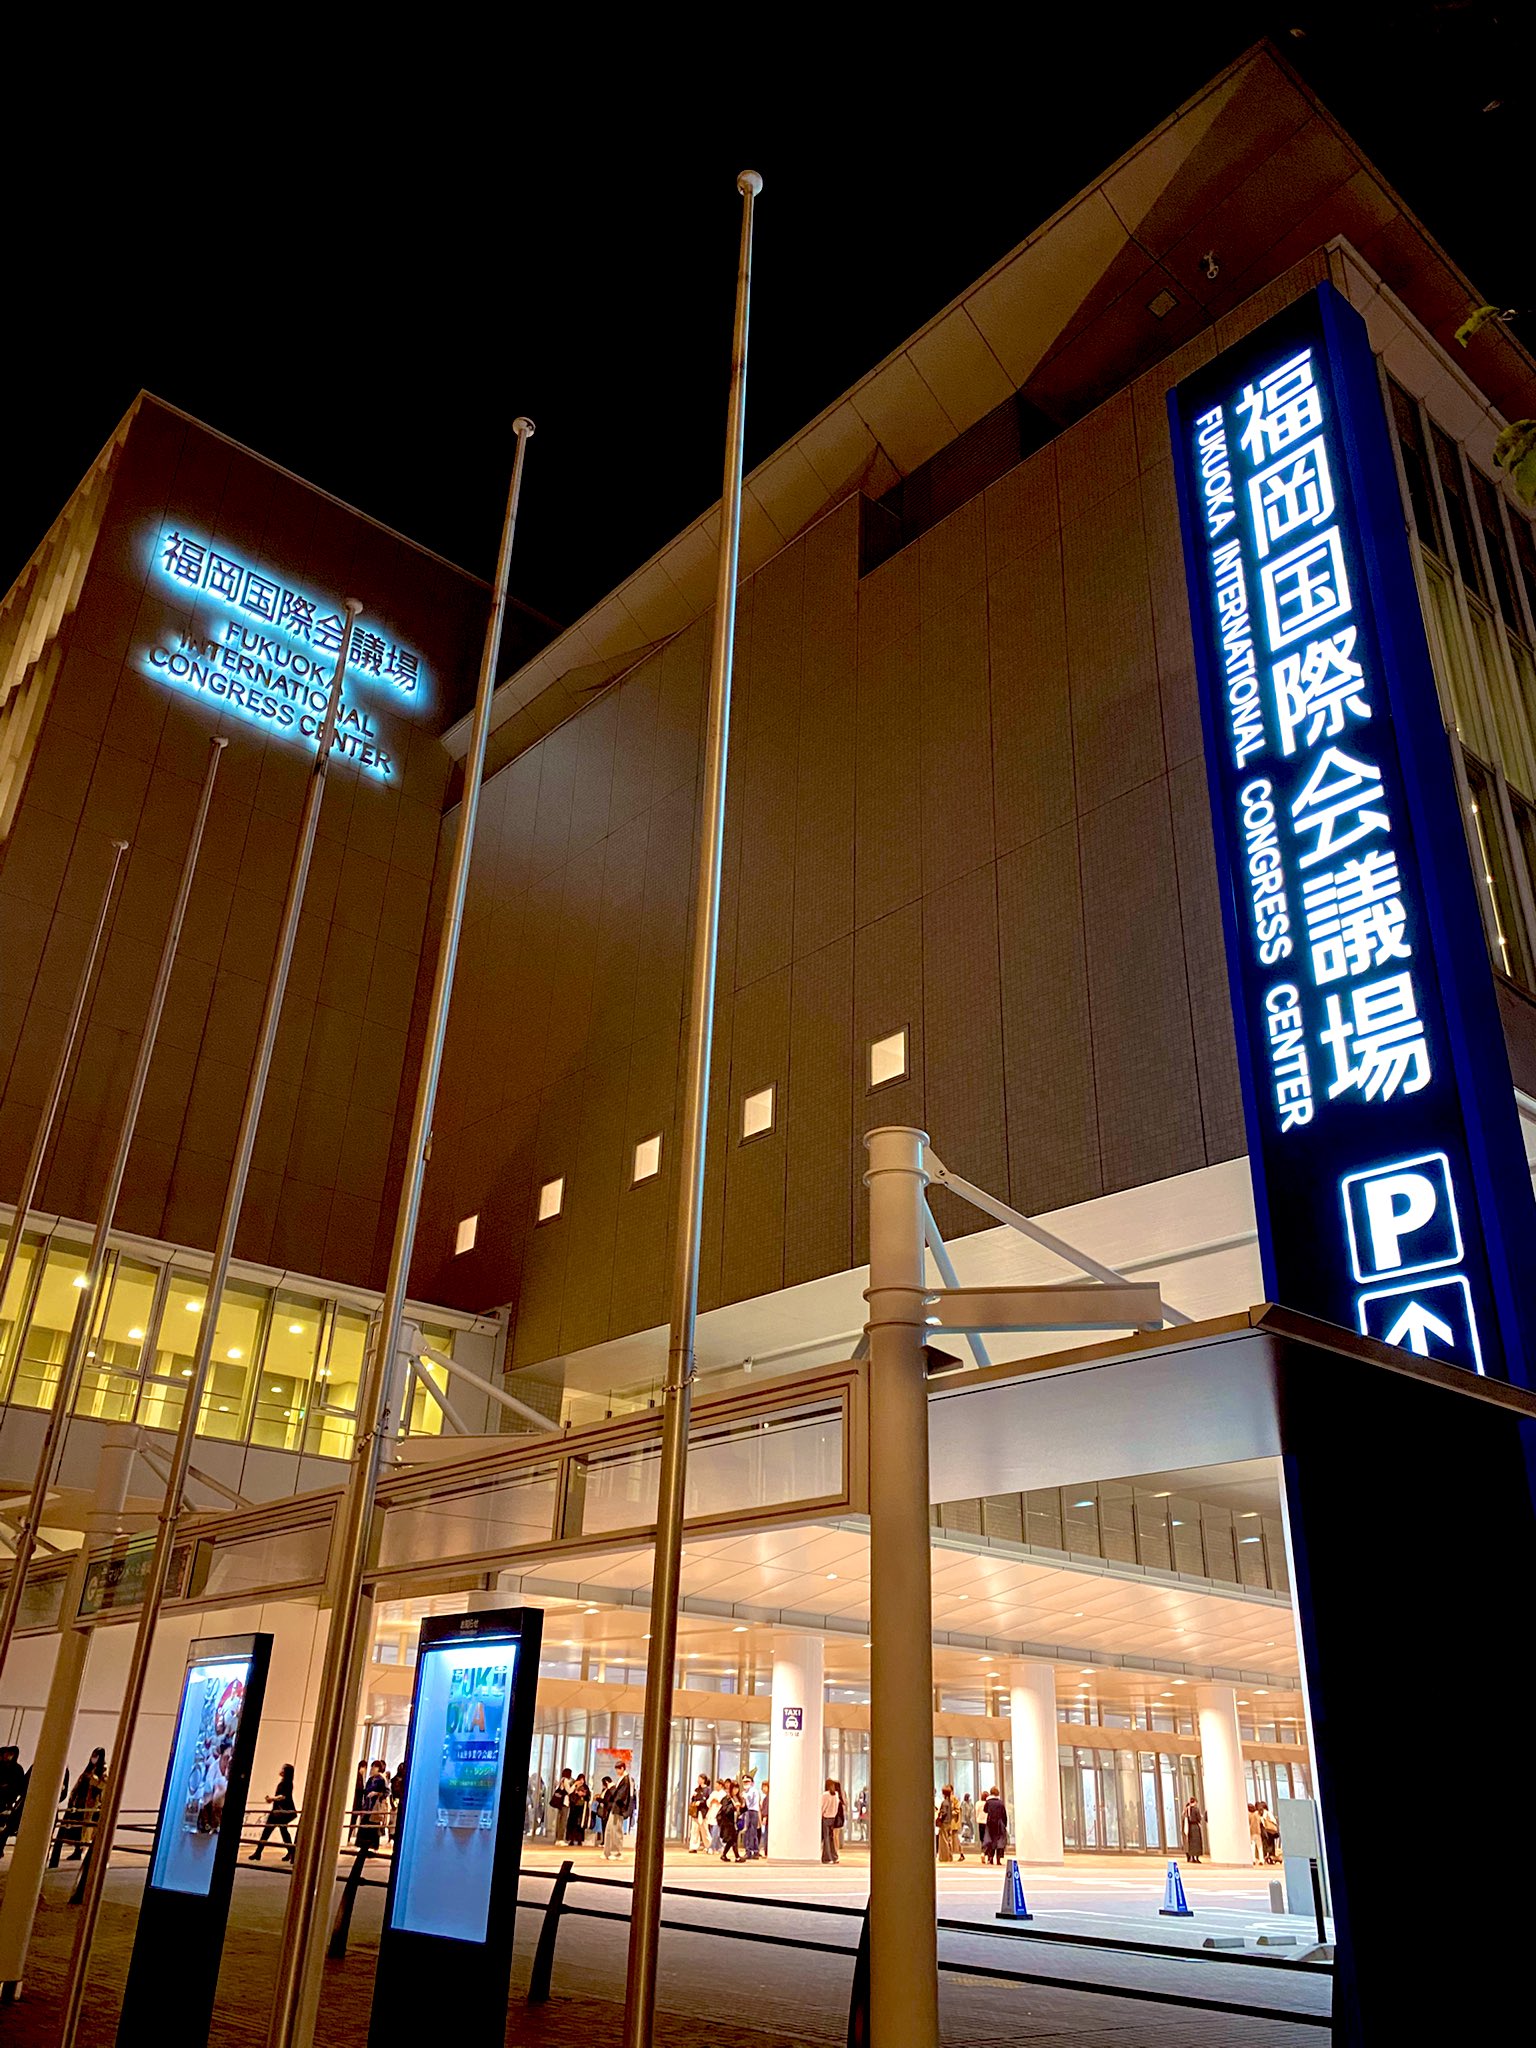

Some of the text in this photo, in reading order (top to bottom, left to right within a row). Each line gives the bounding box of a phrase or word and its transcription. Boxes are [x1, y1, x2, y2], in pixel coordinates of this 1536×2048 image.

[149, 645, 296, 727] CONGRESS
[163, 531, 419, 692] 福岡国際会議場
[1196, 404, 1315, 1134] FUKUOKA INTERNATIONAL CONGRESS CENTER
[1235, 347, 1433, 1103] 福岡国際会議場
[1363, 1172, 1436, 1272] P
